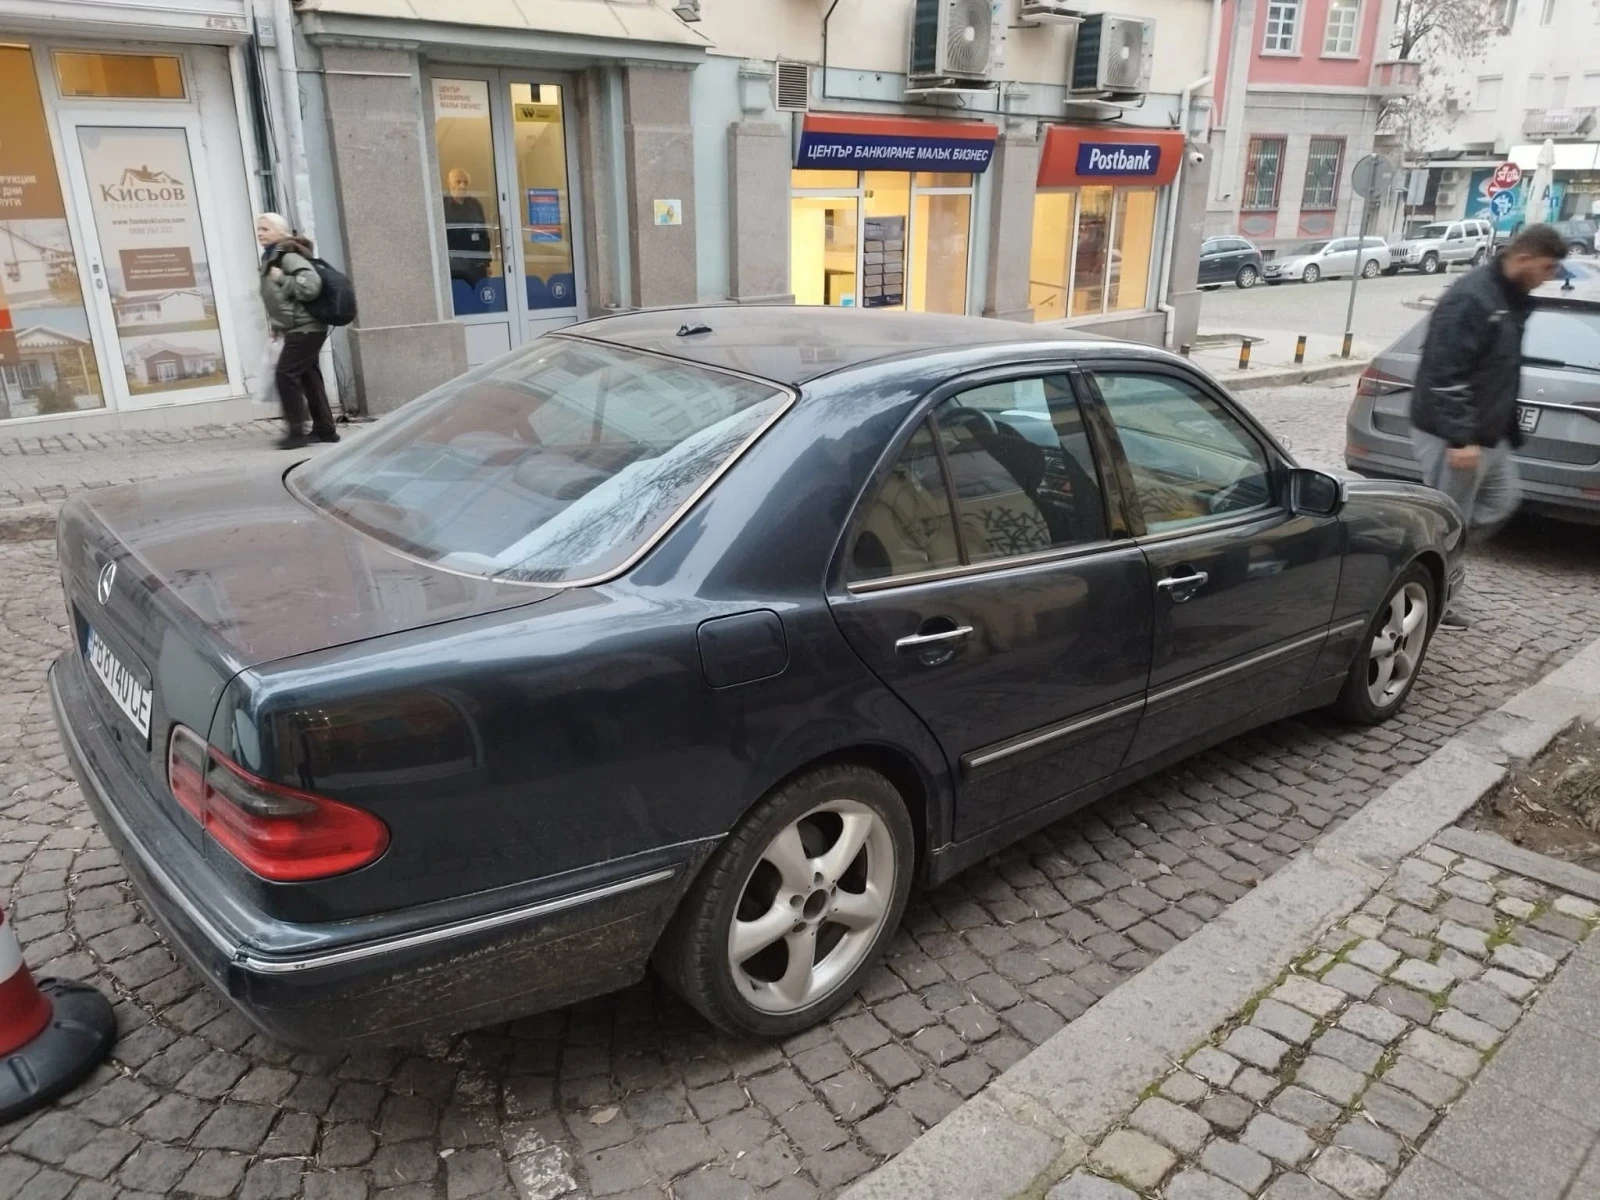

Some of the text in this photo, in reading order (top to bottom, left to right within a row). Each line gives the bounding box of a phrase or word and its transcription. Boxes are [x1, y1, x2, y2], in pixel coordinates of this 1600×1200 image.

[807, 145, 989, 161] ЦЕНТЪР БАНКИРАНЕ МАЛЪК БИЗНЕС
[1088, 147, 1152, 170] Postbank
